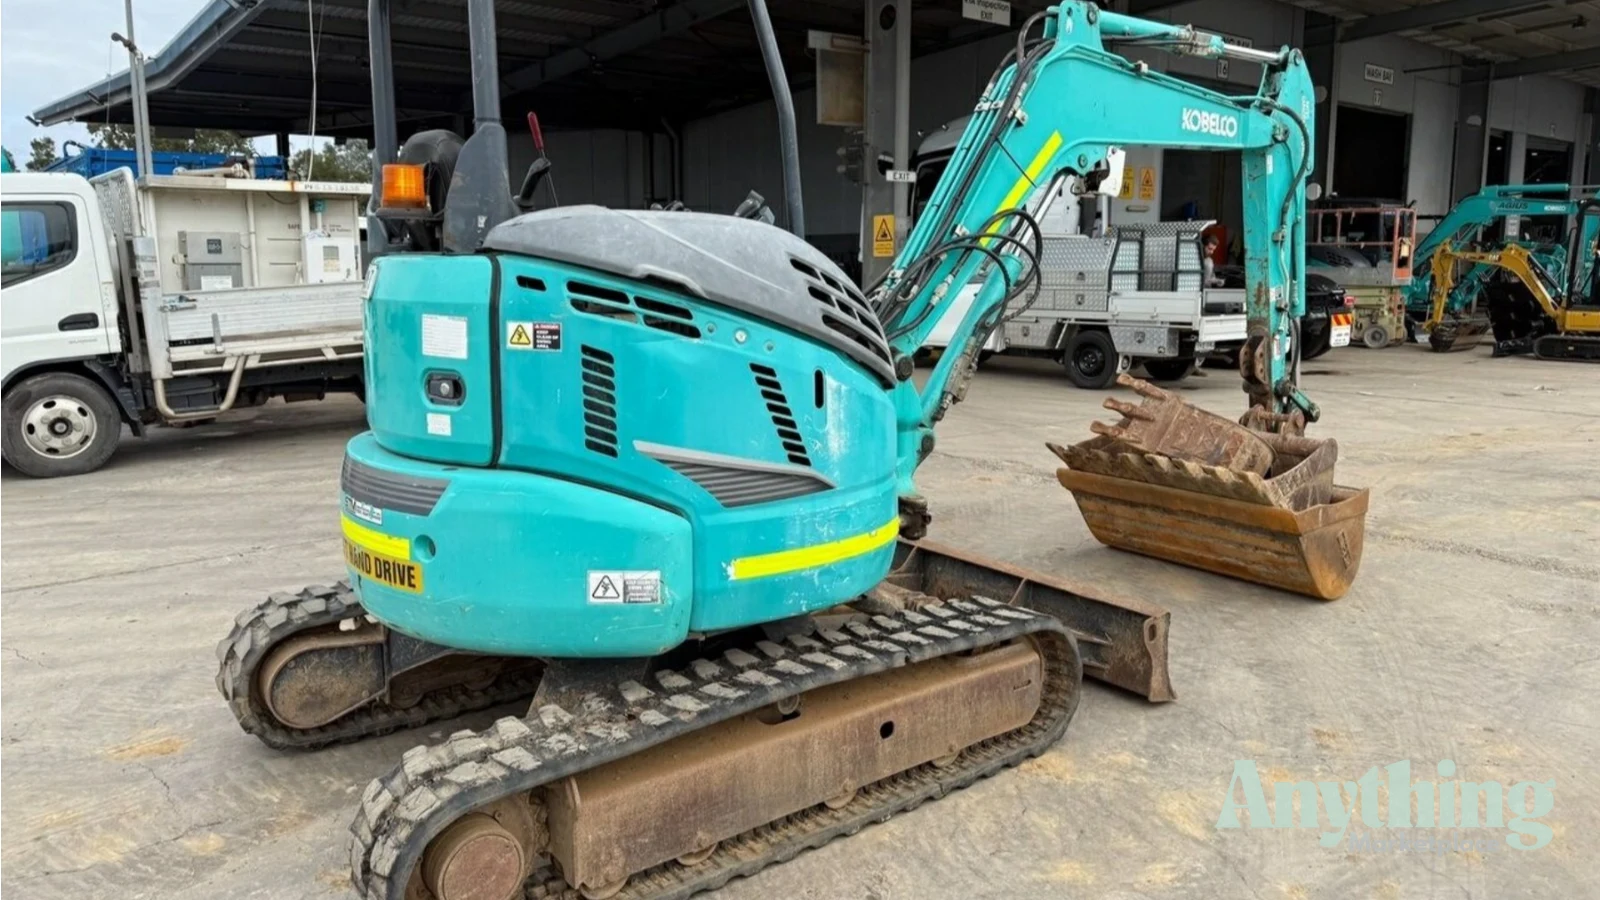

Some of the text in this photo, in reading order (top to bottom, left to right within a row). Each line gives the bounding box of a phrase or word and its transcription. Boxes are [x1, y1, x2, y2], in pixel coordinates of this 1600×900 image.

[1218, 61, 1227, 76] 16
[1181, 107, 1238, 138] KOBELCO
[893, 172, 910, 180] EXIT
[348, 543, 372, 575] HAND
[374, 556, 417, 589] DRIVE
